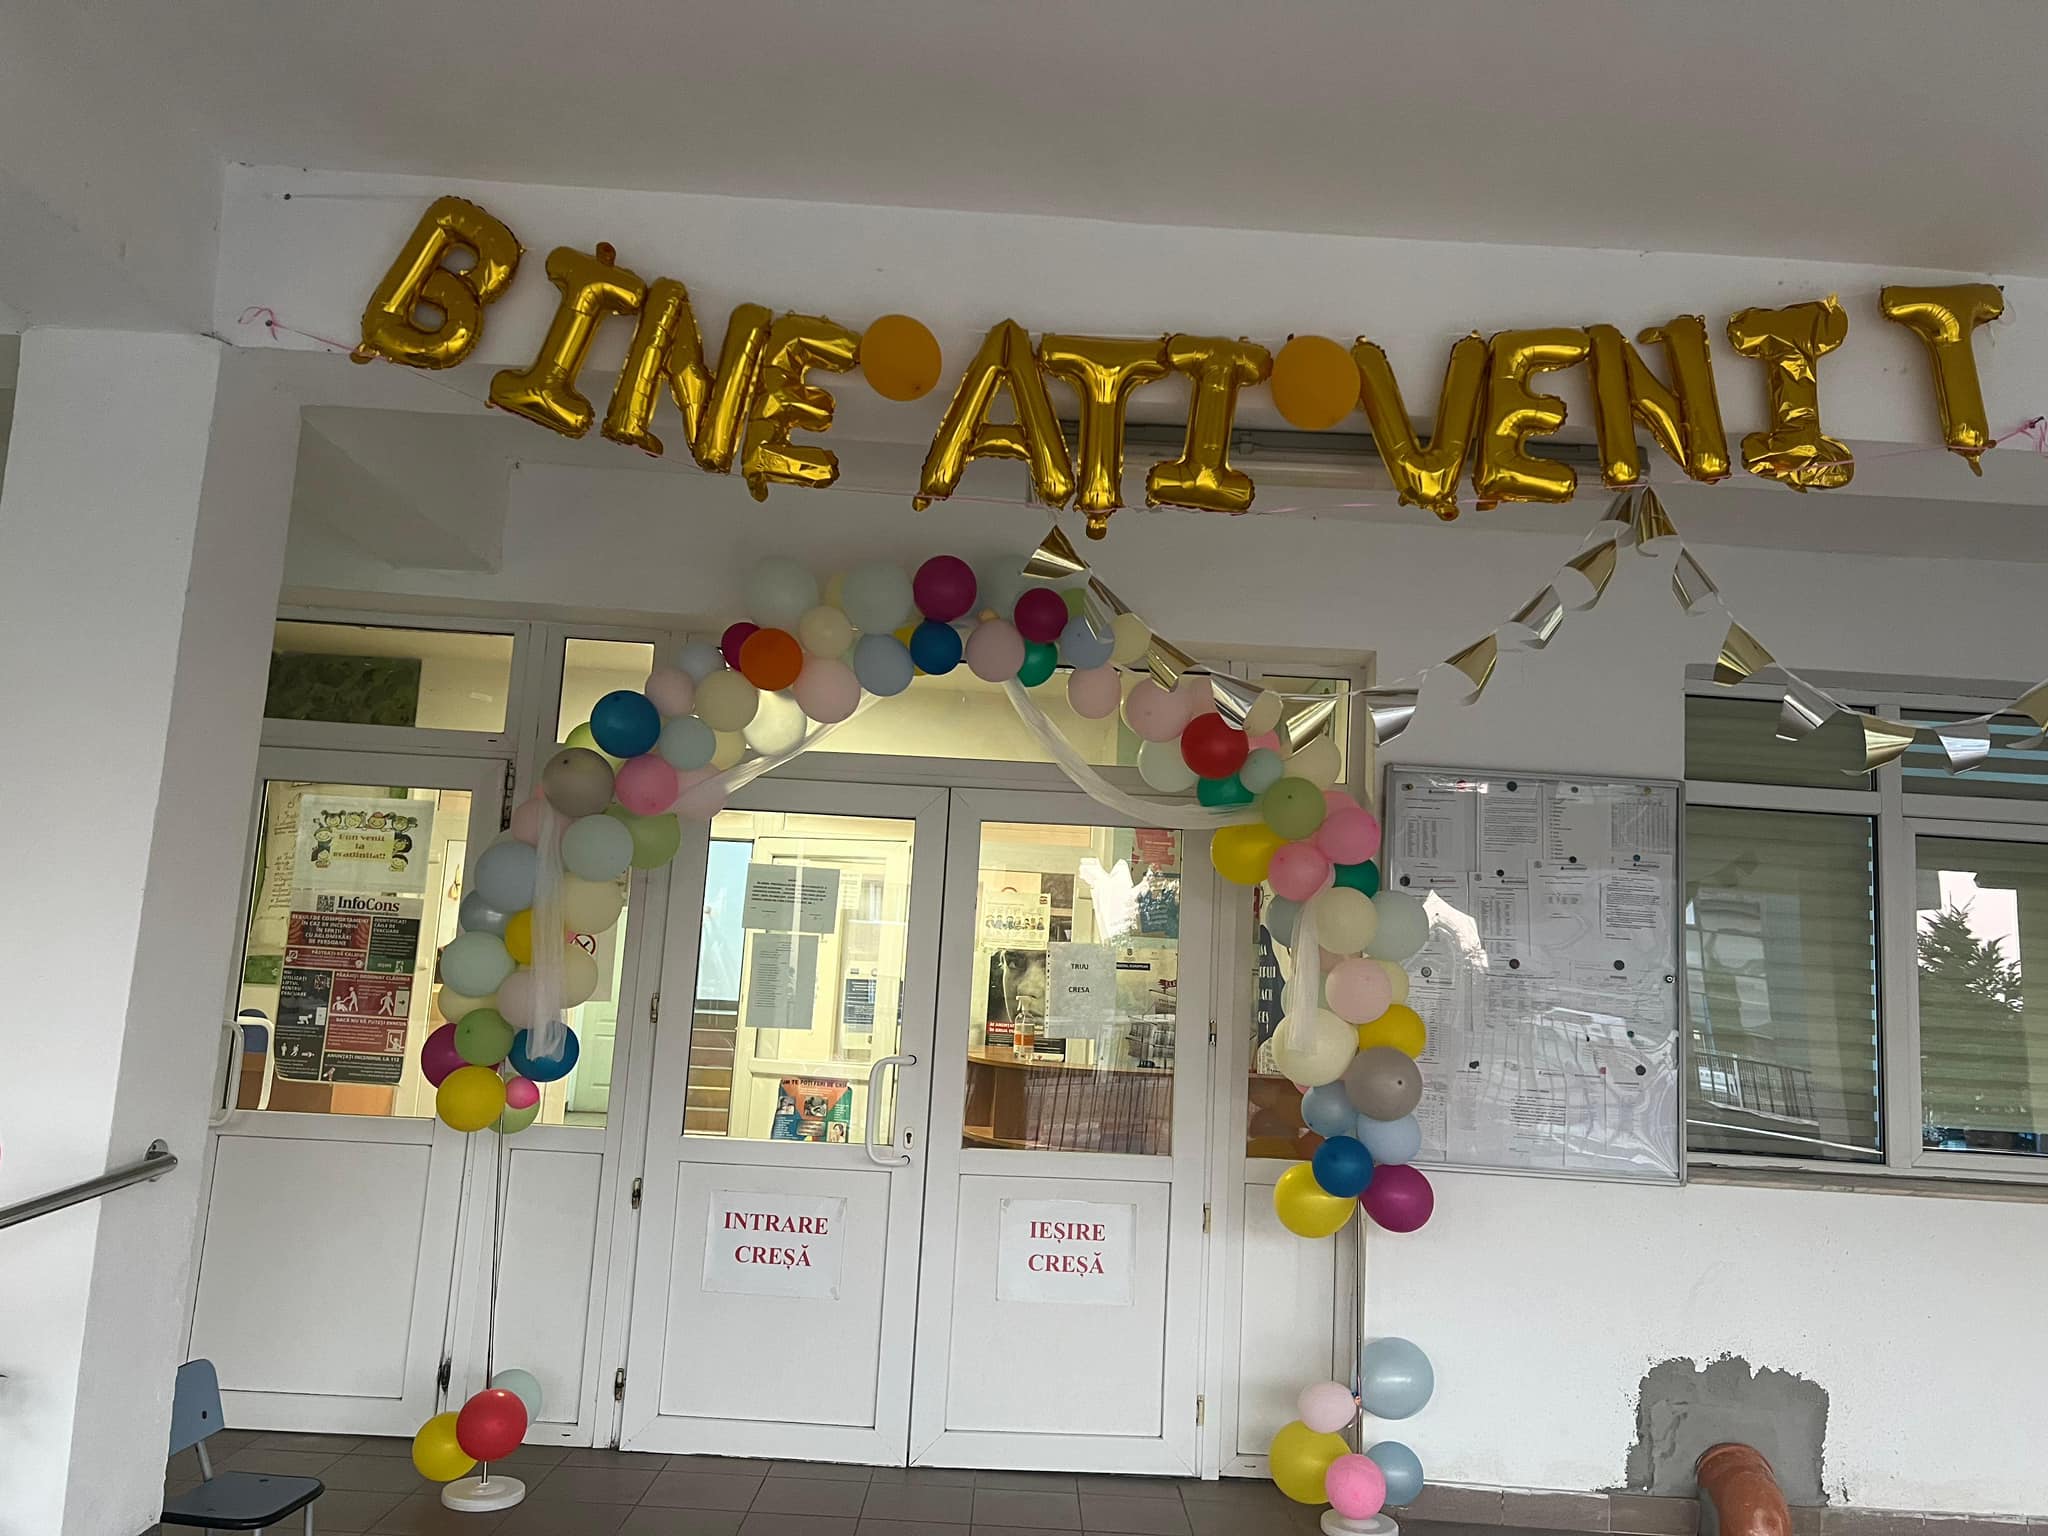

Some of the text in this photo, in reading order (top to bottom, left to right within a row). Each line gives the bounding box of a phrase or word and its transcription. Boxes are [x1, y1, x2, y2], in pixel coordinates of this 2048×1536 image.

[352, 195, 2006, 537] BINE ATI VENIT
[337, 896, 400, 912] InfoCons
[723, 1211, 829, 1236] INTRARE
[1029, 1220, 1106, 1243] IEȘIRE
[735, 1244, 811, 1270] CREȘĂ
[1028, 1251, 1104, 1277] CREȘĂ
